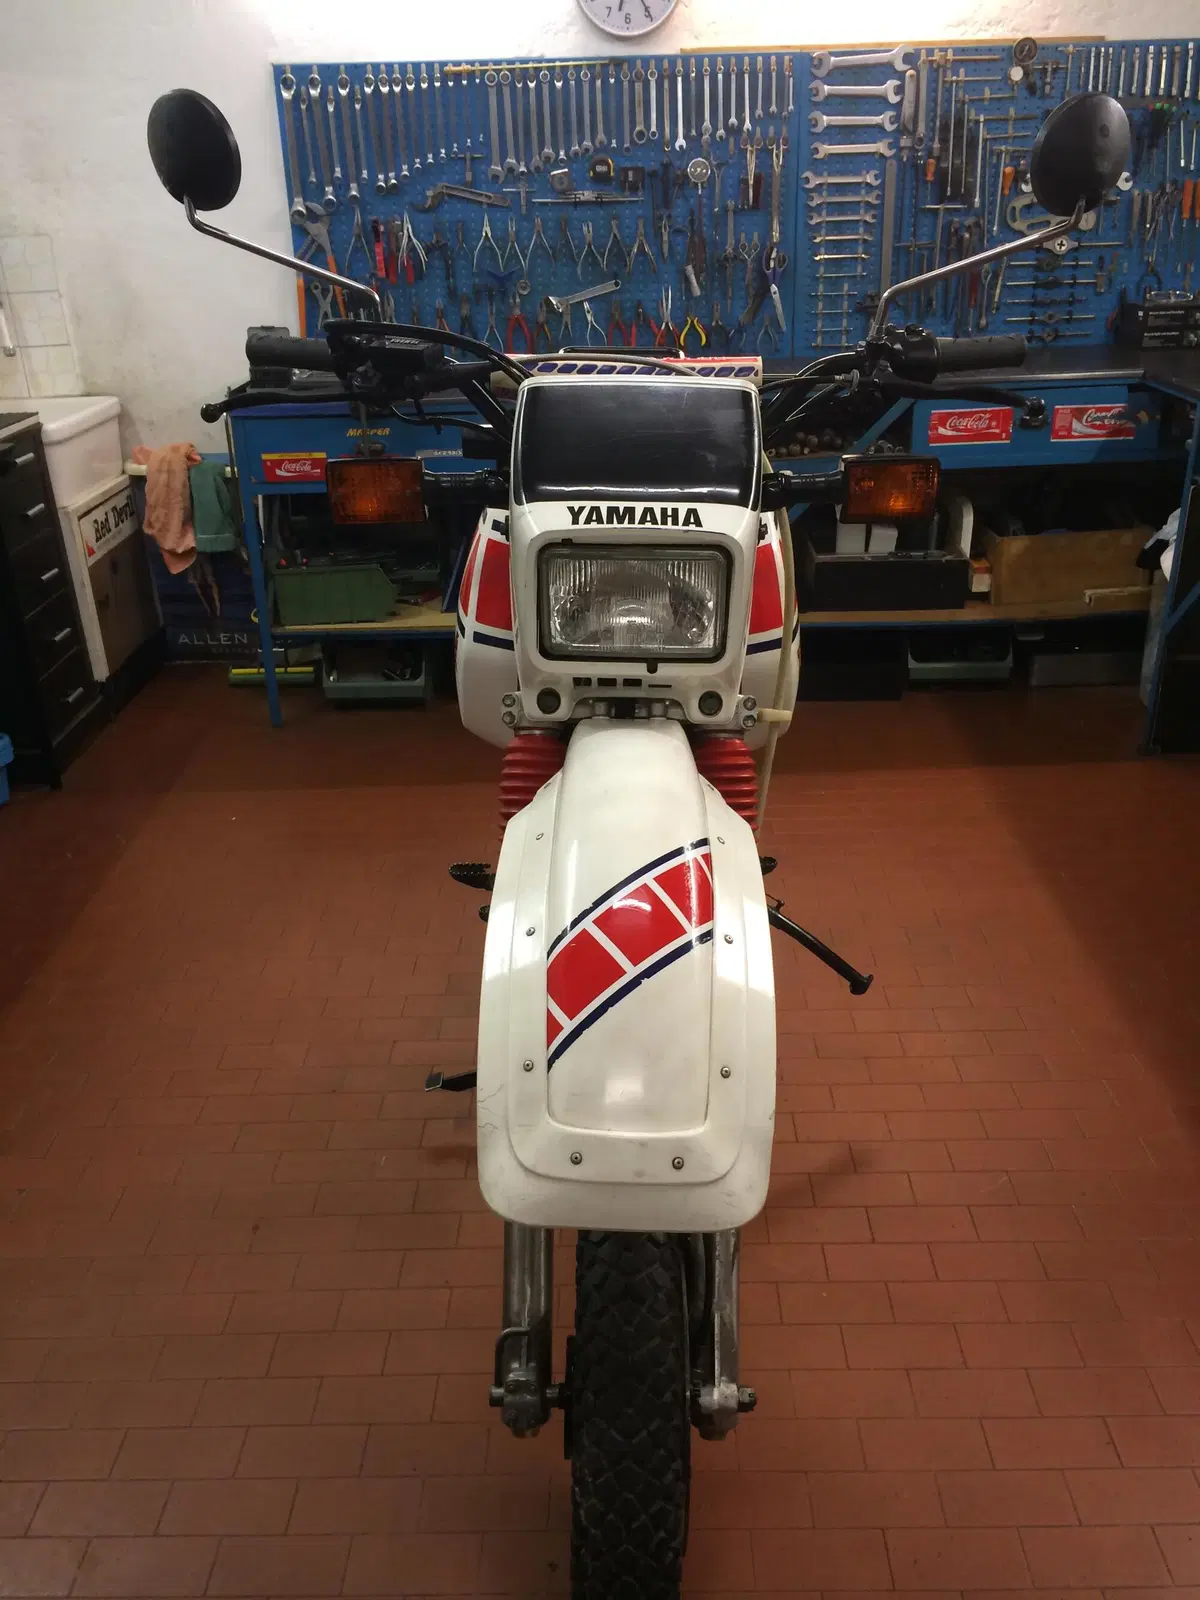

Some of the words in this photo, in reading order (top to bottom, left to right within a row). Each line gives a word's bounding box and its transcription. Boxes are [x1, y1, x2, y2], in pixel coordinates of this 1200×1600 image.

[605, 6, 612, 18] 7
[624, 13, 631, 24] 6
[946, 413, 993, 430] Coca-Cola
[281, 460, 312, 472] Coca-Cola
[566, 506, 703, 528] YAMAHA
[93, 511, 112, 543] Red
[178, 633, 248, 645] ALLEN
